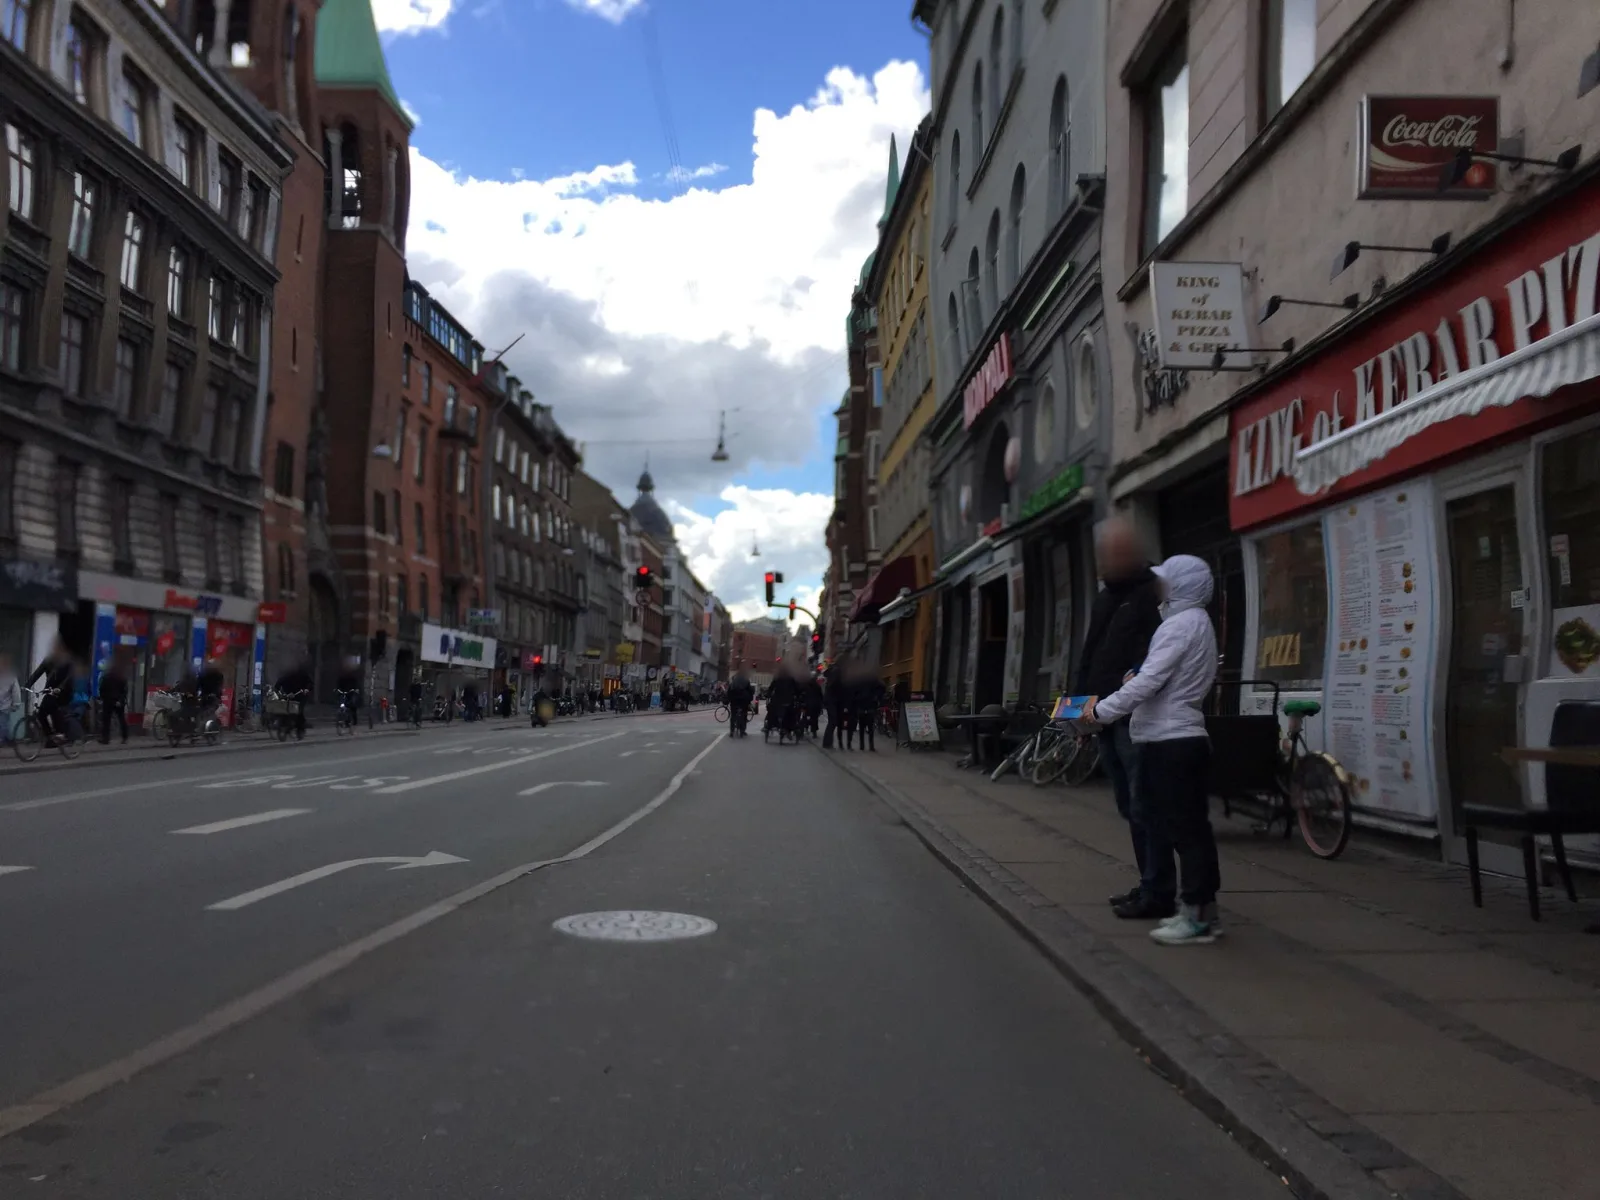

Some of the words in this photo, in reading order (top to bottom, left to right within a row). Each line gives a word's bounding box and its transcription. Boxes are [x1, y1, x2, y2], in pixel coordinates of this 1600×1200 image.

[1176, 276, 1220, 288] KING
[1191, 293, 1210, 306] of
[1171, 309, 1233, 321] KEBAB
[1176, 326, 1231, 337] PIZZA
[1168, 342, 1182, 353] &
[1234, 396, 1304, 498] KING
[1352, 296, 1501, 421] KEBAB
